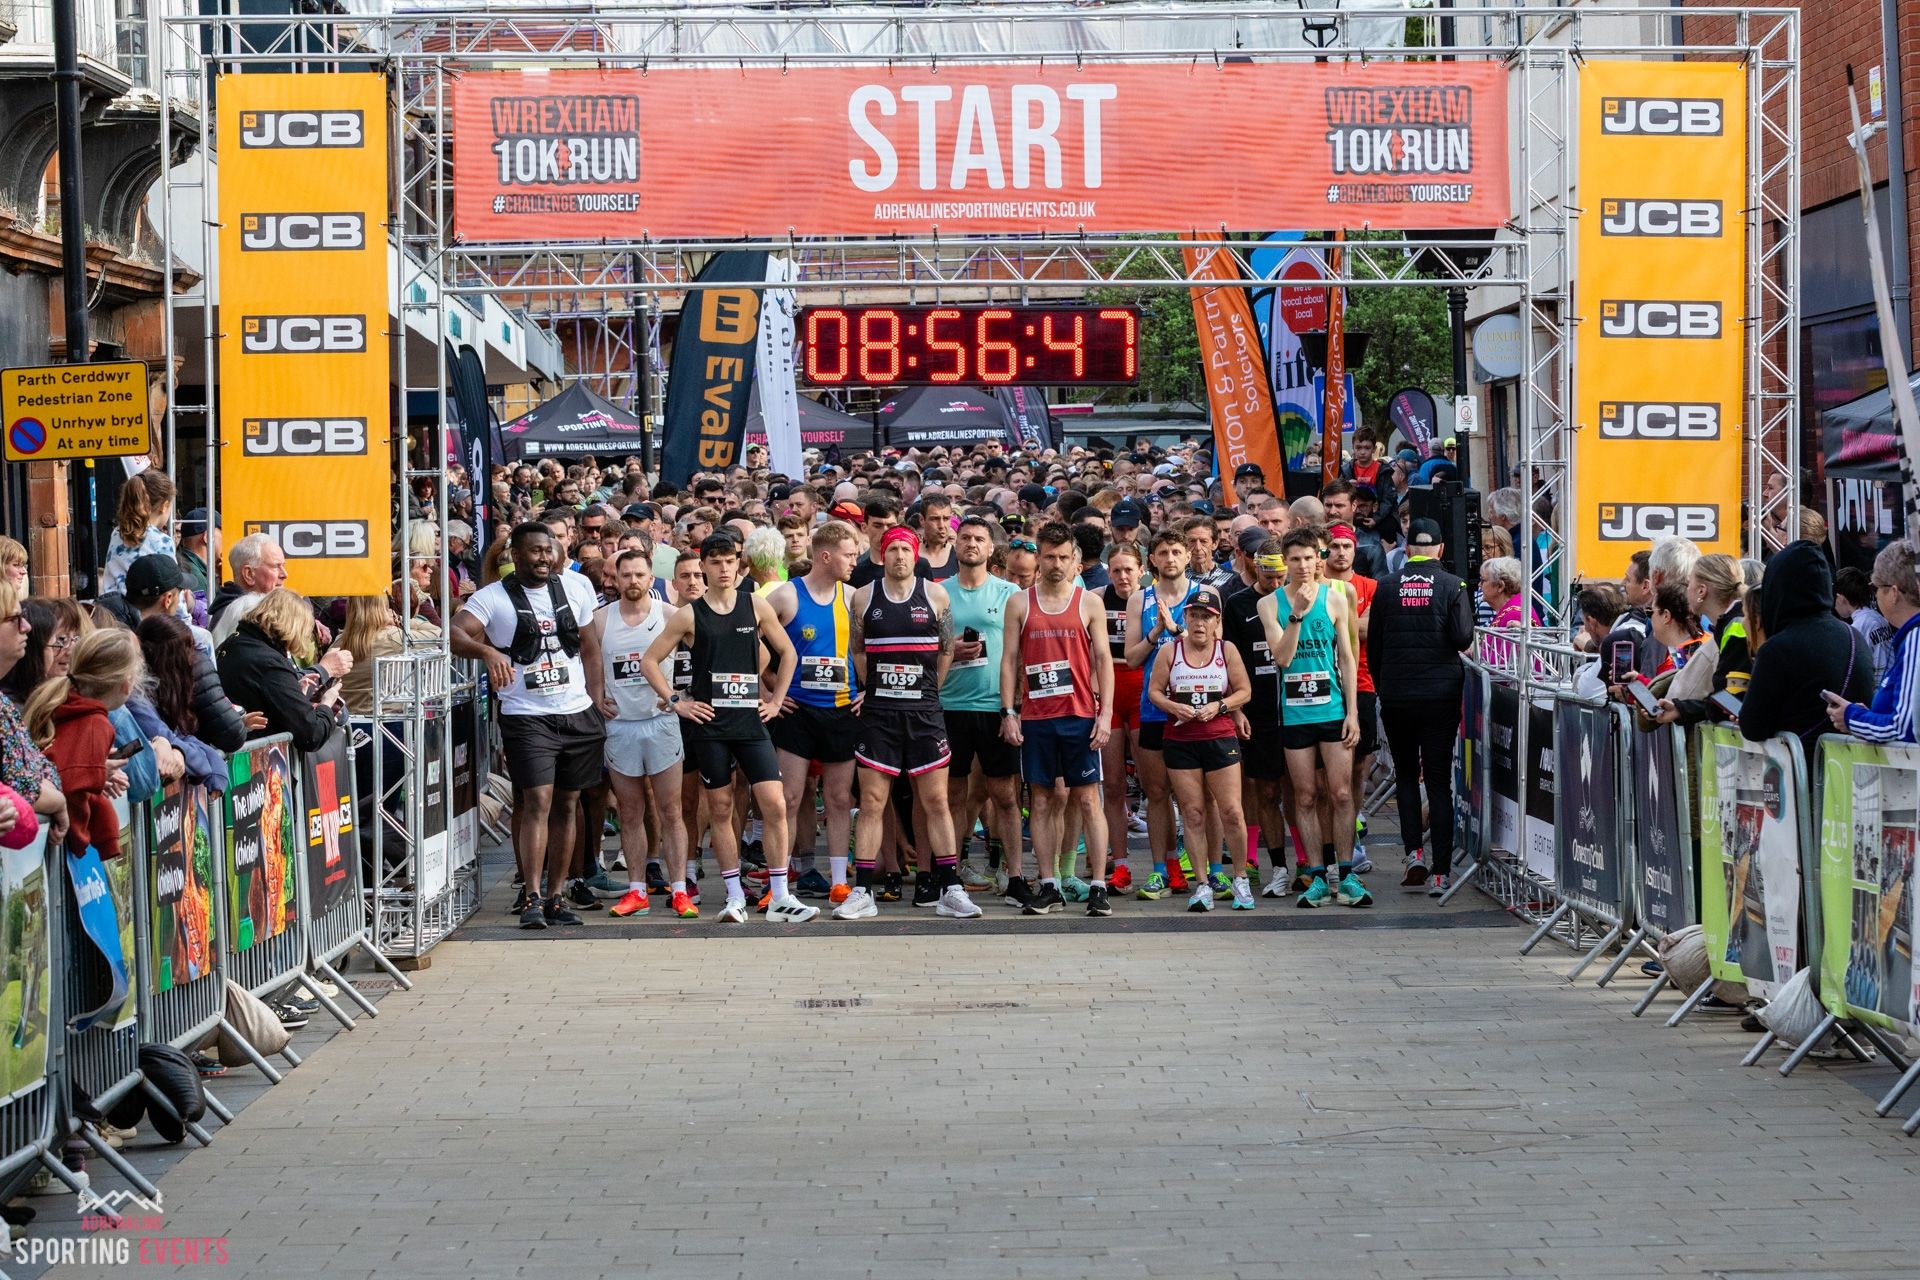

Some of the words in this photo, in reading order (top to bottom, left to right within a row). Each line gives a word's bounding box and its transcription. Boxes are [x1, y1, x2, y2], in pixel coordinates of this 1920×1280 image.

[494, 99, 635, 133] WREXHAM
[1327, 90, 1467, 124] WREXHAM
[1604, 100, 1721, 133] JCB
[243, 113, 362, 146] JCB
[849, 84, 1117, 191] START
[1329, 129, 1393, 171] 10K
[1401, 128, 1469, 170] RUN
[495, 138, 559, 182] 10K
[568, 137, 636, 181] RUN
[874, 201, 1096, 220] ADRENALINESPORTINGEVENTS.CO.UK
[1604, 201, 1720, 234] JCB
[244, 215, 363, 248] JCB
[1282, 296, 1303, 307] vocal
[1303, 293, 1325, 305] about
[1295, 308, 1313, 319] local
[1603, 304, 1719, 335] JCB
[245, 318, 363, 350] JCB
[808, 311, 1135, 382] 08:56:47
[1230, 312, 1260, 414] Solicitors
[18, 373, 56, 386] Parth
[61, 371, 131, 384] Cerddwyr
[18, 393, 93, 407] Pedestrian
[98, 391, 133, 403] Zone
[51, 417, 106, 430] Unrhyw
[111, 413, 143, 427] bryd
[557, 419, 606, 432] SPORTING
[608, 420, 640, 431] EVENT
[1602, 405, 1718, 437] JCB
[57, 438, 73, 449] At
[78, 438, 103, 450] any
[108, 435, 140, 447] time
[246, 420, 364, 453] JCB
[1221, 400, 1250, 470] aron
[1601, 506, 1716, 538] JCB
[1399, 588, 1433, 597] SPORTING
[1402, 597, 1430, 606] EVENTS
[1030, 630, 1063, 639] WREXHAM
[535, 669, 560, 684] 318
[815, 666, 834, 677] 56
[881, 673, 917, 686] 1039
[1039, 671, 1059, 685] 88
[722, 682, 749, 695] 106
[1298, 681, 1318, 693] 48
[1191, 692, 1208, 705] 81
